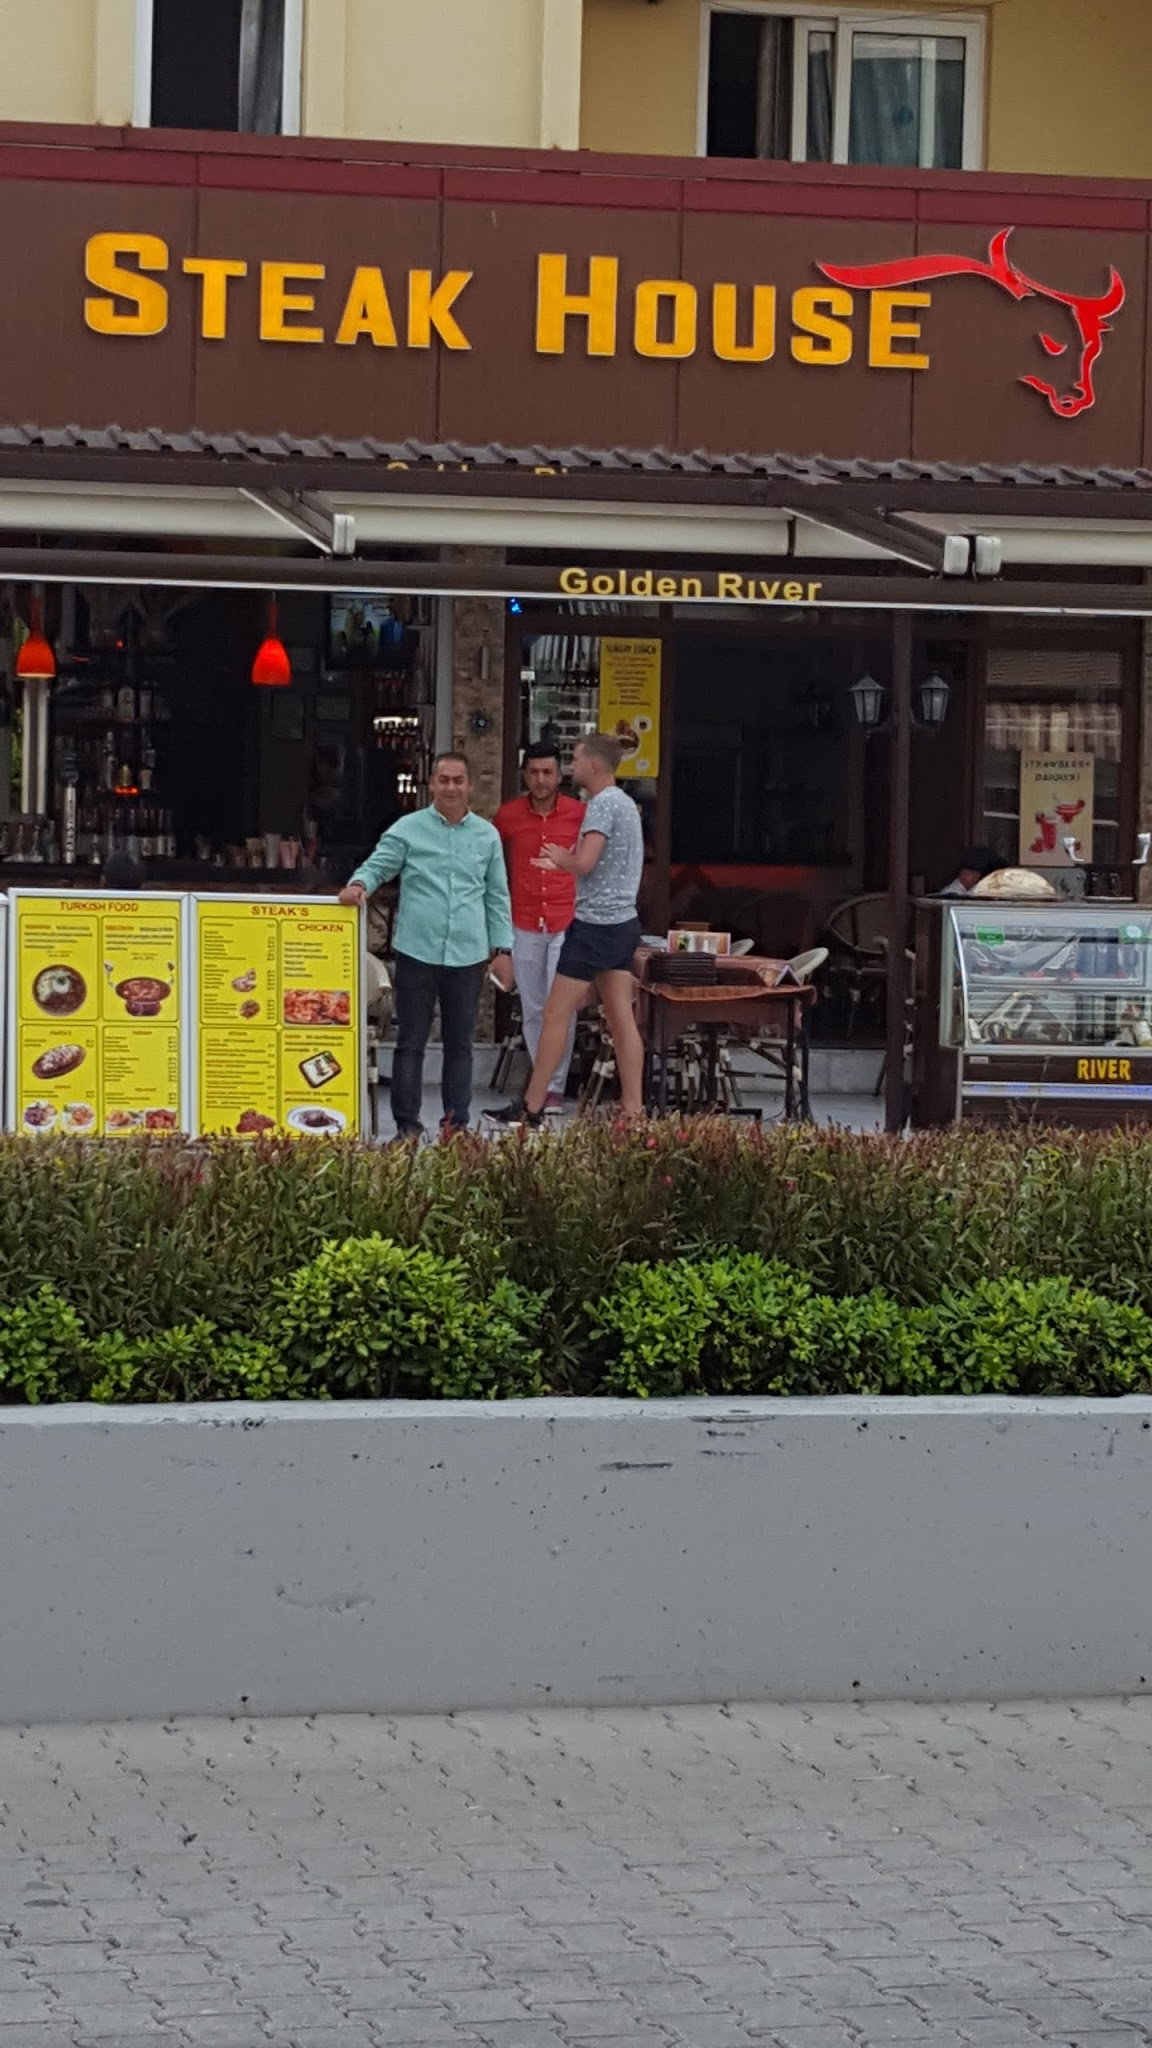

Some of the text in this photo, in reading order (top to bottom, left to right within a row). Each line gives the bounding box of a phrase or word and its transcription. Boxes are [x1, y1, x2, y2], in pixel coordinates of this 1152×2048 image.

[84, 232, 933, 371] STEAK HOUSE
[558, 566, 823, 602] Golden River
[60, 901, 139, 912] TURKISH FOOD
[297, 923, 344, 933] CHICKEN
[1077, 1058, 1132, 1081] RIVER
